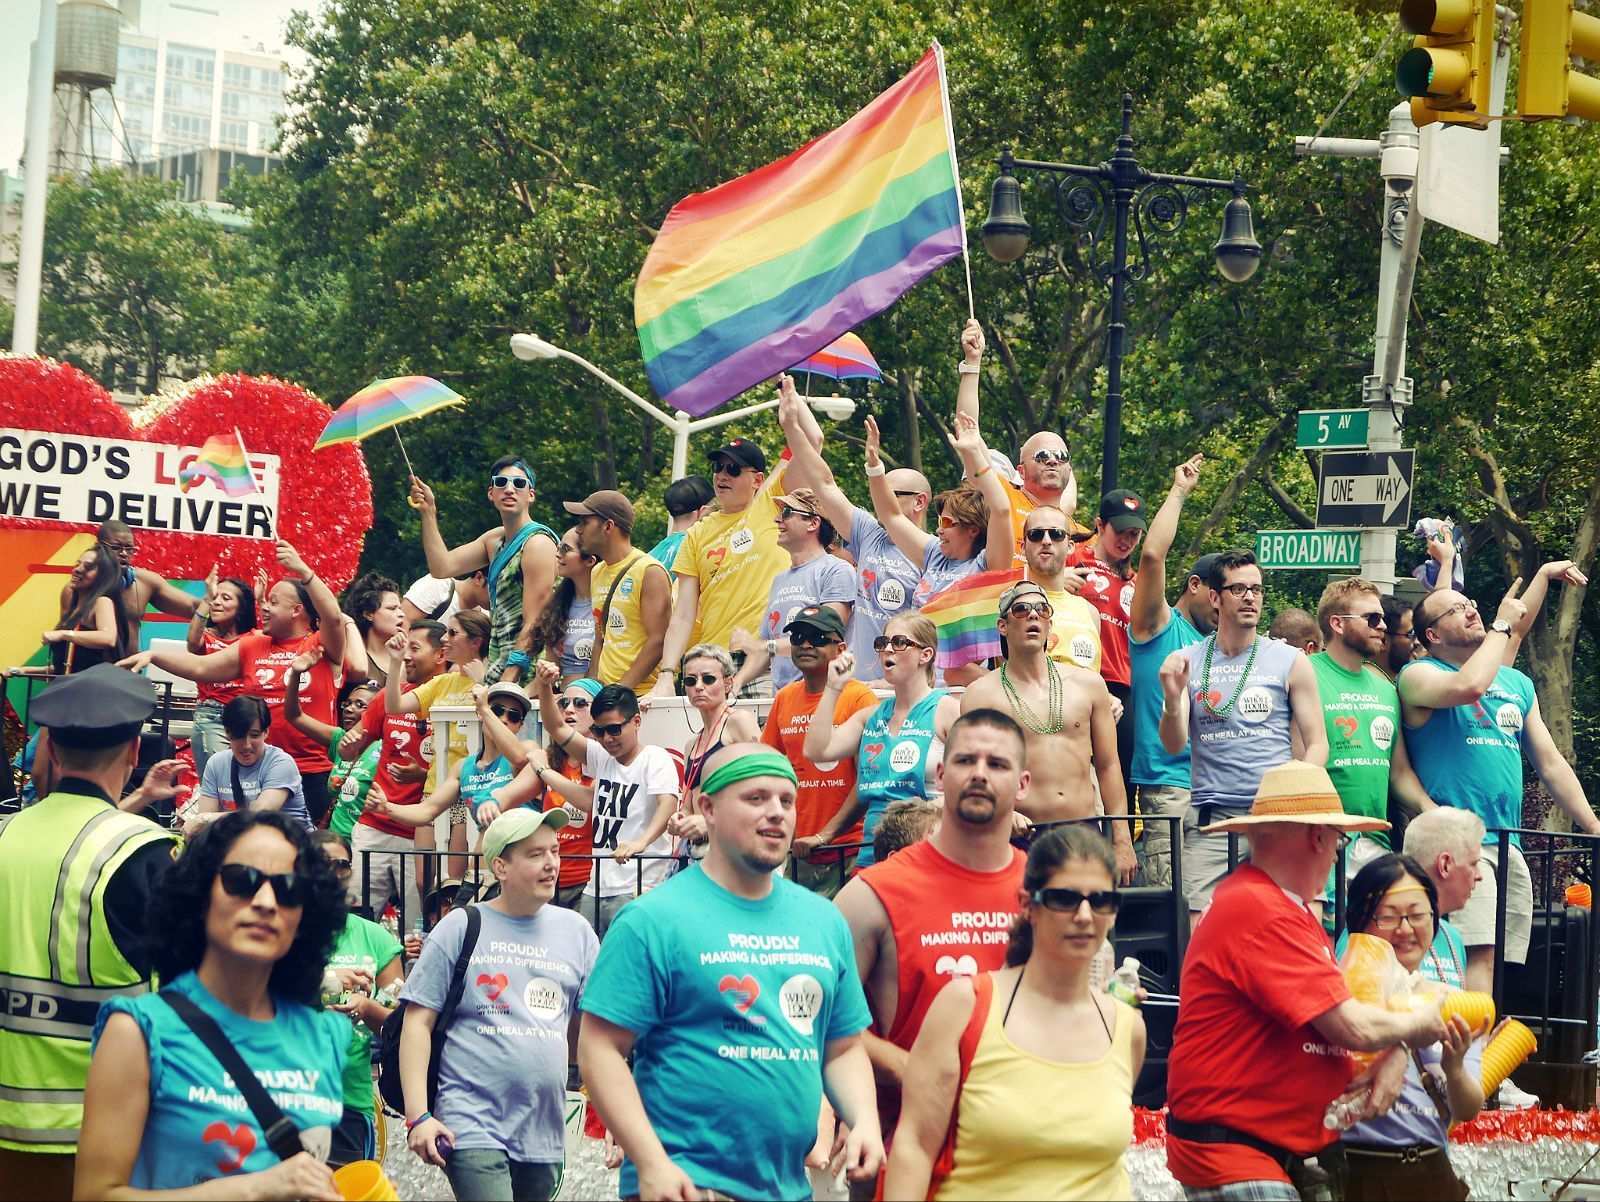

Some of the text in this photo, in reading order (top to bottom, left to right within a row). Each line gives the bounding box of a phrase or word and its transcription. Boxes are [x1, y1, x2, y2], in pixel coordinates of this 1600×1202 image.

[1317, 414, 1352, 444] 5 AV
[0, 436, 131, 480] GOD'S
[1331, 477, 1402, 502] ONE WAY
[0, 482, 273, 538] WE DELIVER
[1259, 534, 1360, 563] BROADWAY
[598, 779, 639, 819] GAY
[728, 933, 801, 950] PROUDLY
[921, 931, 971, 946] MAKING
[972, 932, 982, 944] A
[490, 942, 549, 957] PROUDLY
[700, 952, 749, 965] MAKING
[2, 988, 58, 1019] PD
[477, 1025, 496, 1035] ONE
[718, 1045, 748, 1060] ONE
[751, 1046, 786, 1060] MEAL
[1303, 1042, 1326, 1056] ONE
